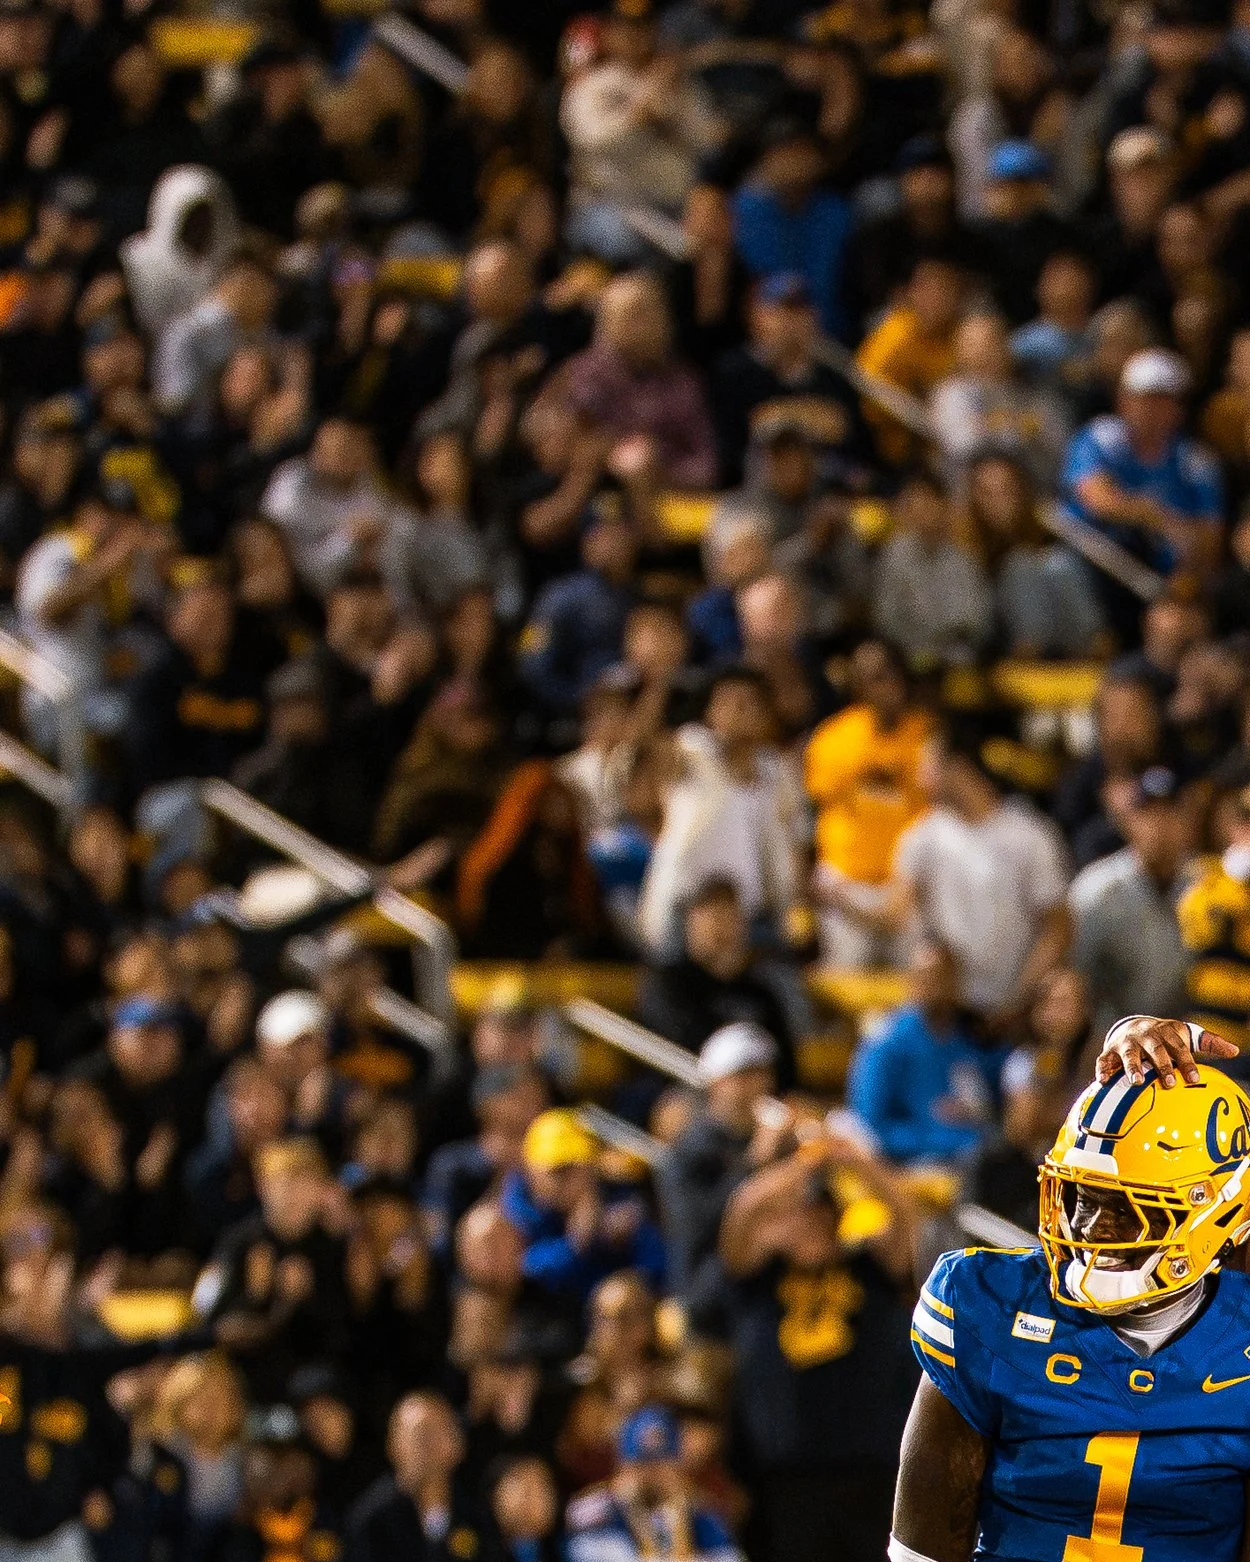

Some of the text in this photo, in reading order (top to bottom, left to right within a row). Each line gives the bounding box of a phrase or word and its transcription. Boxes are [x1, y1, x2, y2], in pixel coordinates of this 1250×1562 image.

[1020, 1321, 1051, 1336] dialpad
[1045, 1353, 1082, 1385] C
[1129, 1369, 1155, 1393] C
